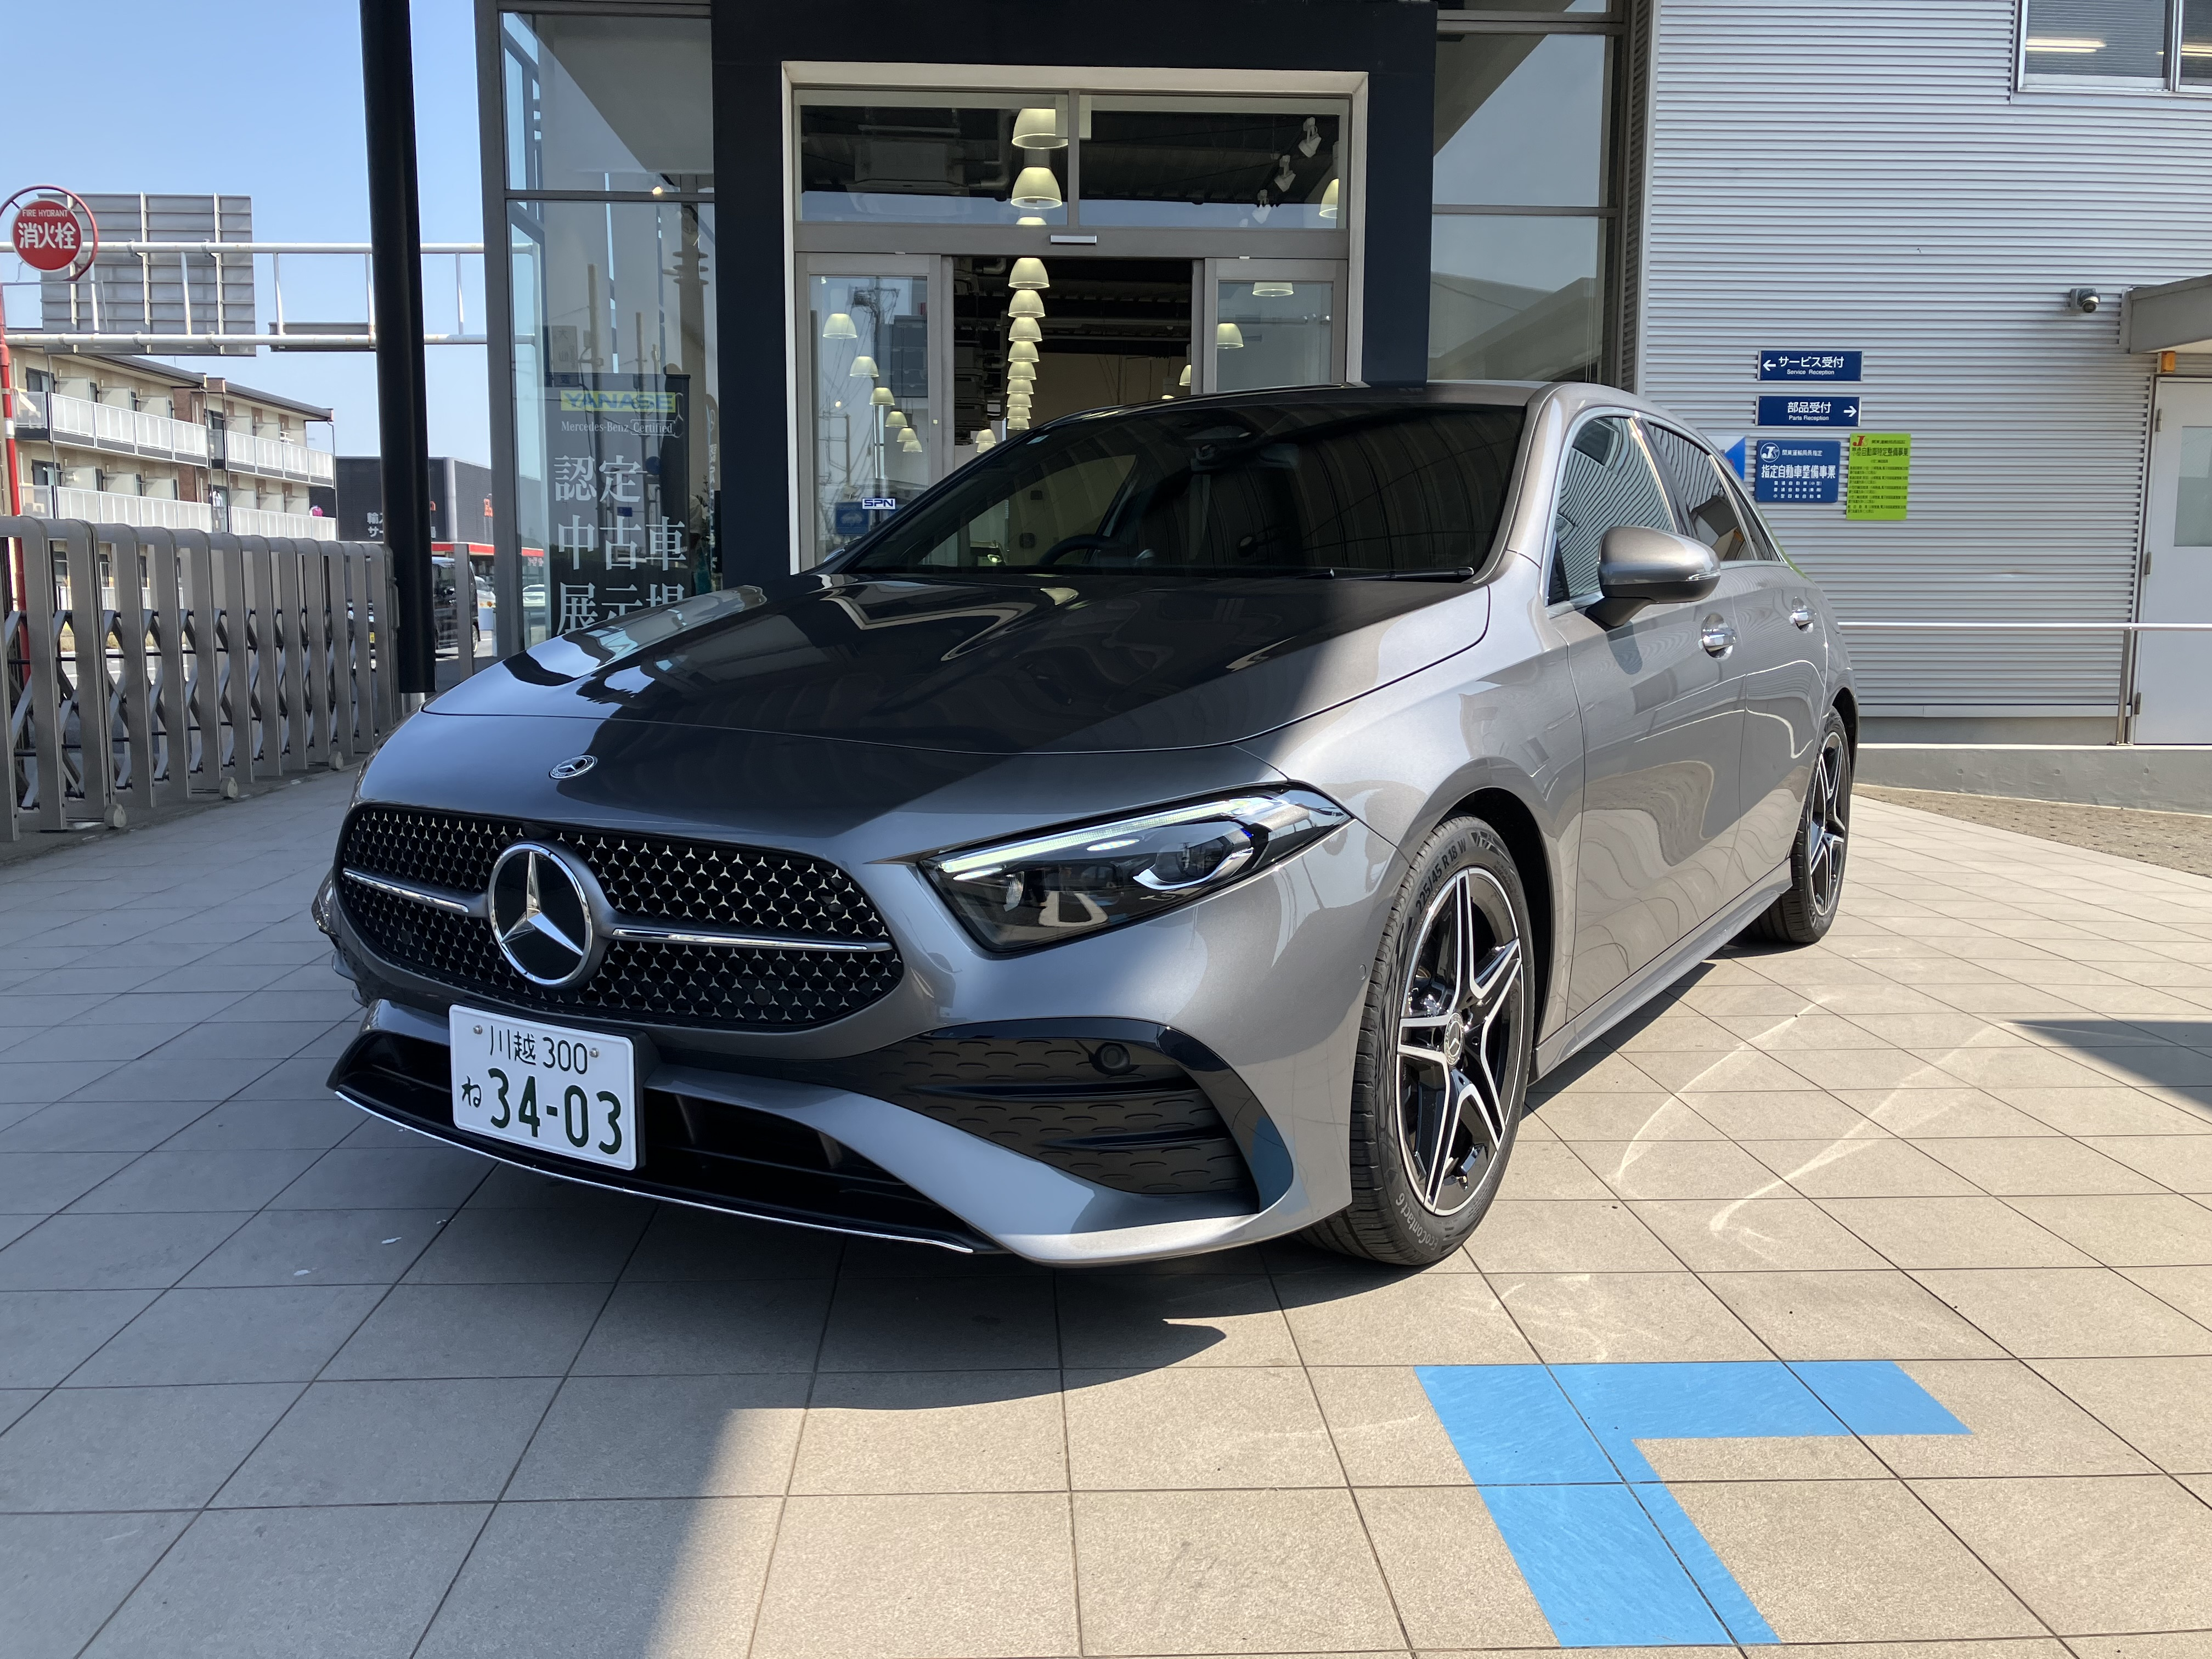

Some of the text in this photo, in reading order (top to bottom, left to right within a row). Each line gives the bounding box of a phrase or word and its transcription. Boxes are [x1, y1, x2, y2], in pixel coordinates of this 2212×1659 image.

[22, 209, 68, 217] FIRE HYDRANT
[18, 222, 76, 249] 消火栓
[1778, 356, 1844, 368] サービス受付
[563, 392, 674, 410] YANASE
[1787, 402, 1832, 414] 部品受付
[561, 421, 673, 433] Mercedes-Benz Certified
[554, 455, 641, 503] 認定
[1761, 464, 1836, 479] 指定自動車整備事業
[557, 514, 686, 571] 中古車
[1415, 864, 1442, 915] 225/45
[1457, 838, 1466, 854] W
[490, 1025, 588, 1074] 川越 300
[461, 1068, 622, 1155] ね 34-03
[1400, 1201, 1439, 1251] EcoContact
